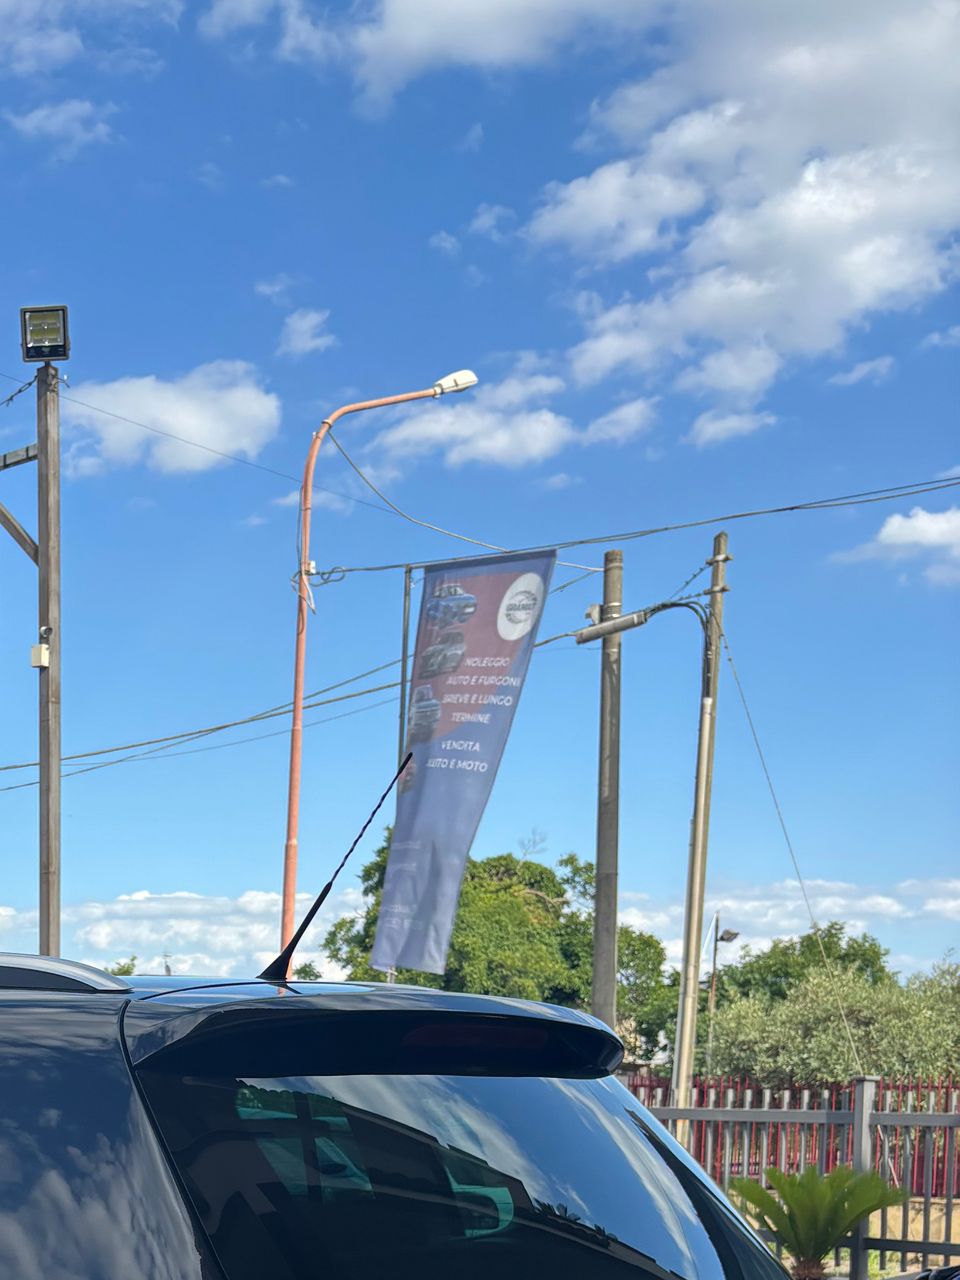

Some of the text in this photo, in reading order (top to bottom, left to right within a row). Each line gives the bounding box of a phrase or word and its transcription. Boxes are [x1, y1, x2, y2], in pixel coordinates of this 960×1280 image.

[464, 657, 510, 667] NOLEGGIO
[446, 676, 470, 686] AUTO
[478, 676, 521, 687] FURGONI
[477, 694, 513, 706] LUNGO
[451, 712, 491, 724] TERMINE
[441, 740, 481, 753] VENDITA
[456, 760, 489, 773] MOTO
